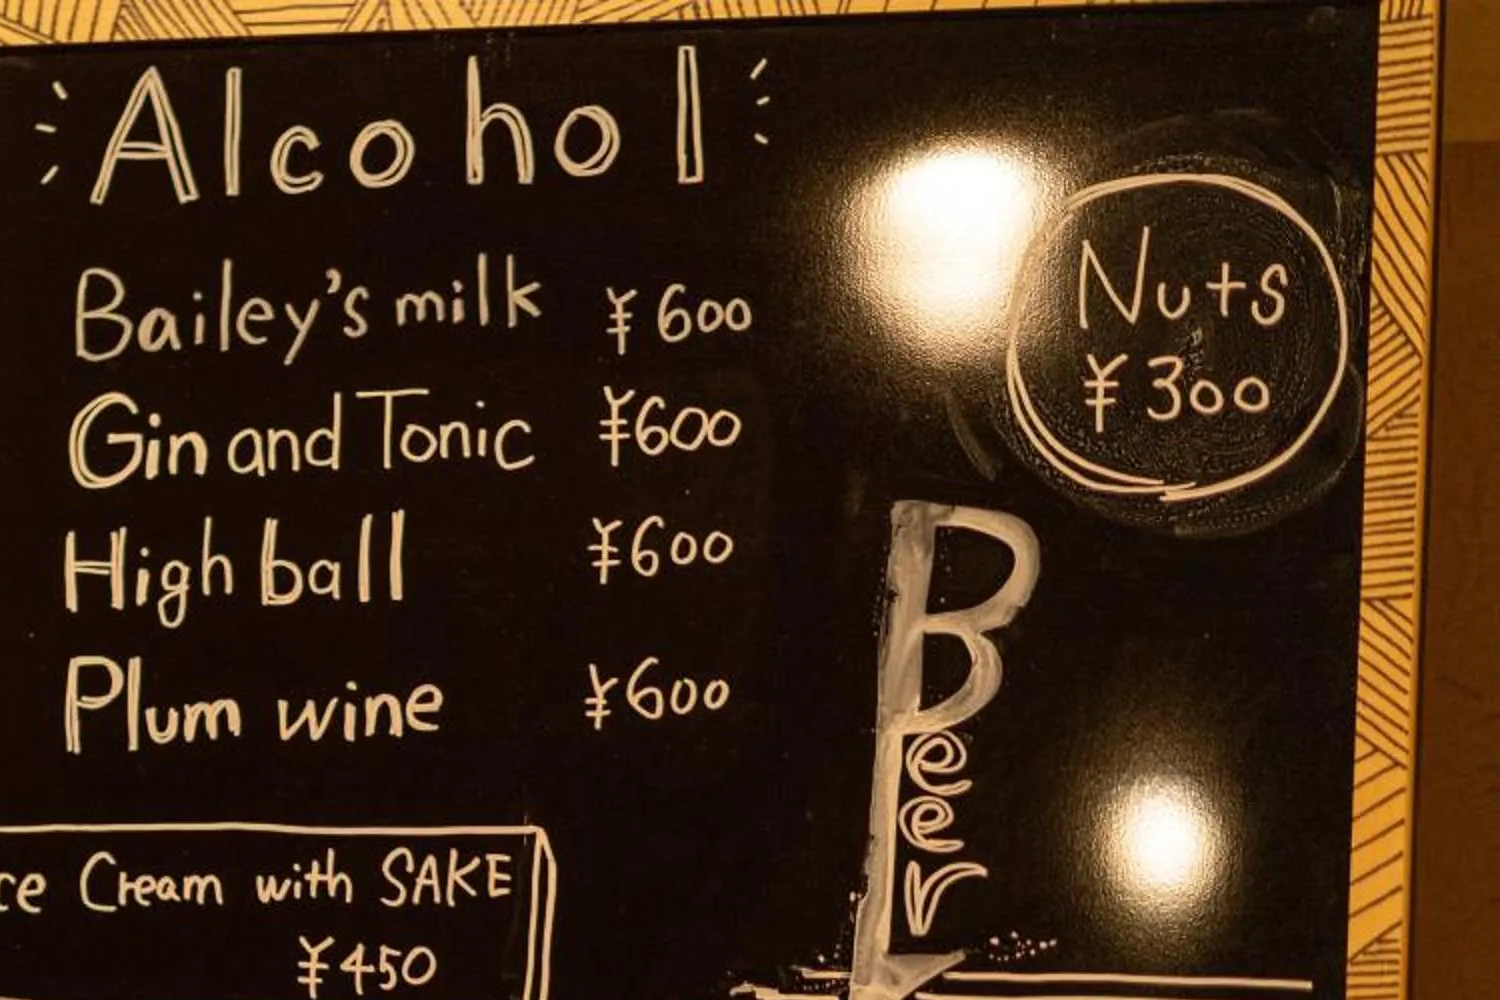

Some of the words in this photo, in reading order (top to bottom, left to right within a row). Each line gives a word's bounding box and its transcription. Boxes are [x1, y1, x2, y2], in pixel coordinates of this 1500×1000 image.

[90, 46, 704, 204] Alcohol
[75, 258, 369, 366] Bailey's
[395, 252, 541, 329] milk
[606, 283, 752, 356] ¥600
[1077, 226, 1289, 330] Nuts
[68, 391, 208, 490] Gin
[227, 391, 342, 478] and
[355, 388, 535, 471] Tonic
[598, 385, 742, 467] ¥600
[1083, 353, 1271, 434] ¥300
[587, 515, 734, 585] ¥600
[64, 655, 242, 755] Plum
[277, 680, 444, 742] wine
[584, 656, 730, 731] ¥600
[79, 851, 224, 913] Cream
[255, 847, 353, 904] with
[379, 846, 512, 908] SAKE
[297, 935, 437, 1000] ¥450
